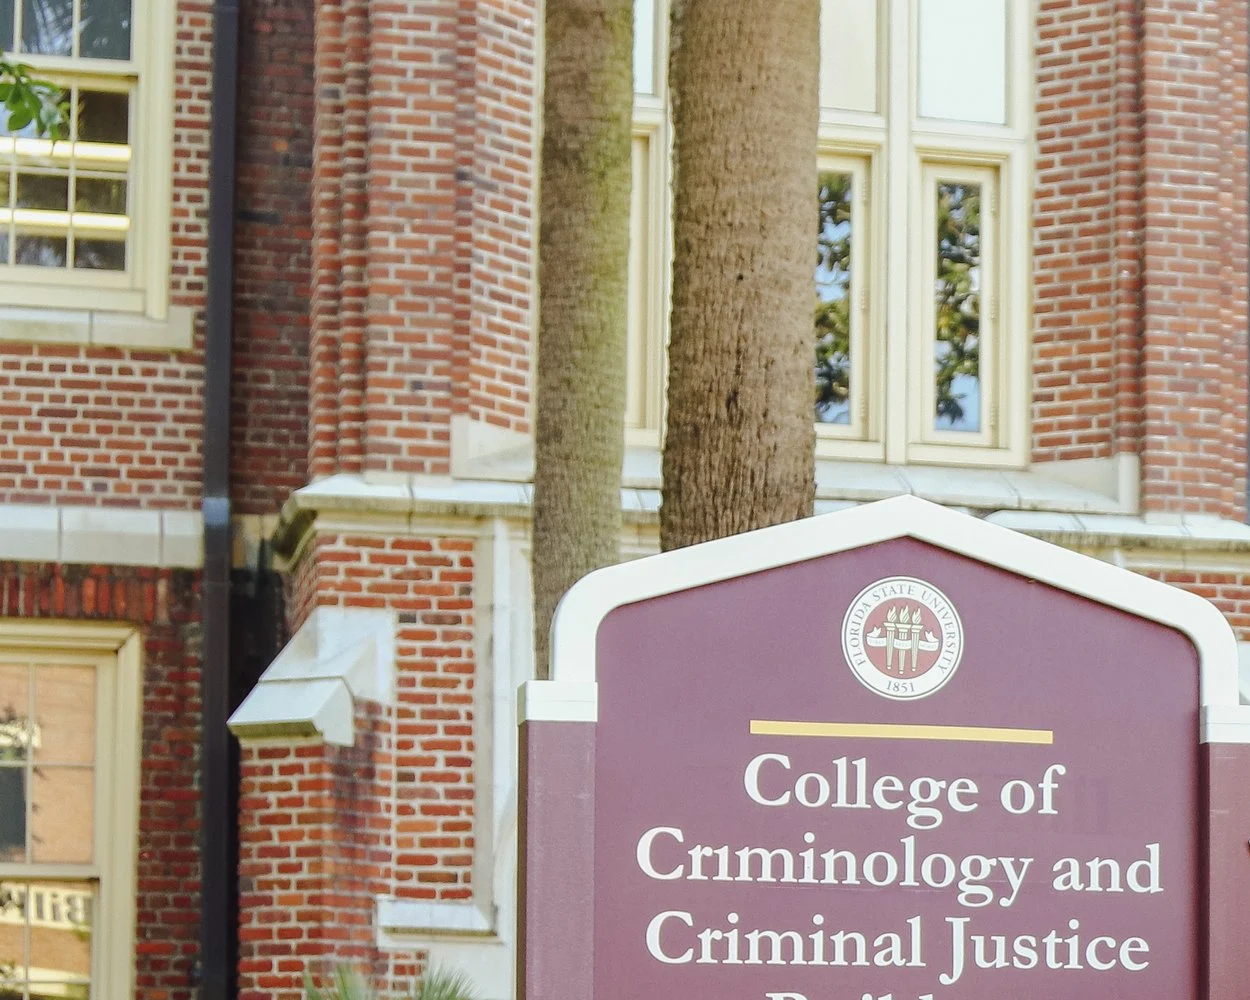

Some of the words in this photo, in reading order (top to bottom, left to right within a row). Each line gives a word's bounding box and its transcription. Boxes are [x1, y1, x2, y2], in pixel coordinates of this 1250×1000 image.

[850, 603, 871, 666] FLORIDA
[873, 585, 916, 602] STATE
[921, 591, 956, 675] UNIVERSITY
[886, 680, 915, 693] 1851
[745, 754, 978, 829] College
[1001, 765, 1066, 814] of
[637, 827, 1033, 907] Criminology
[1053, 843, 1163, 893] and
[647, 911, 926, 966] Criminal
[940, 917, 1149, 984] Justice
